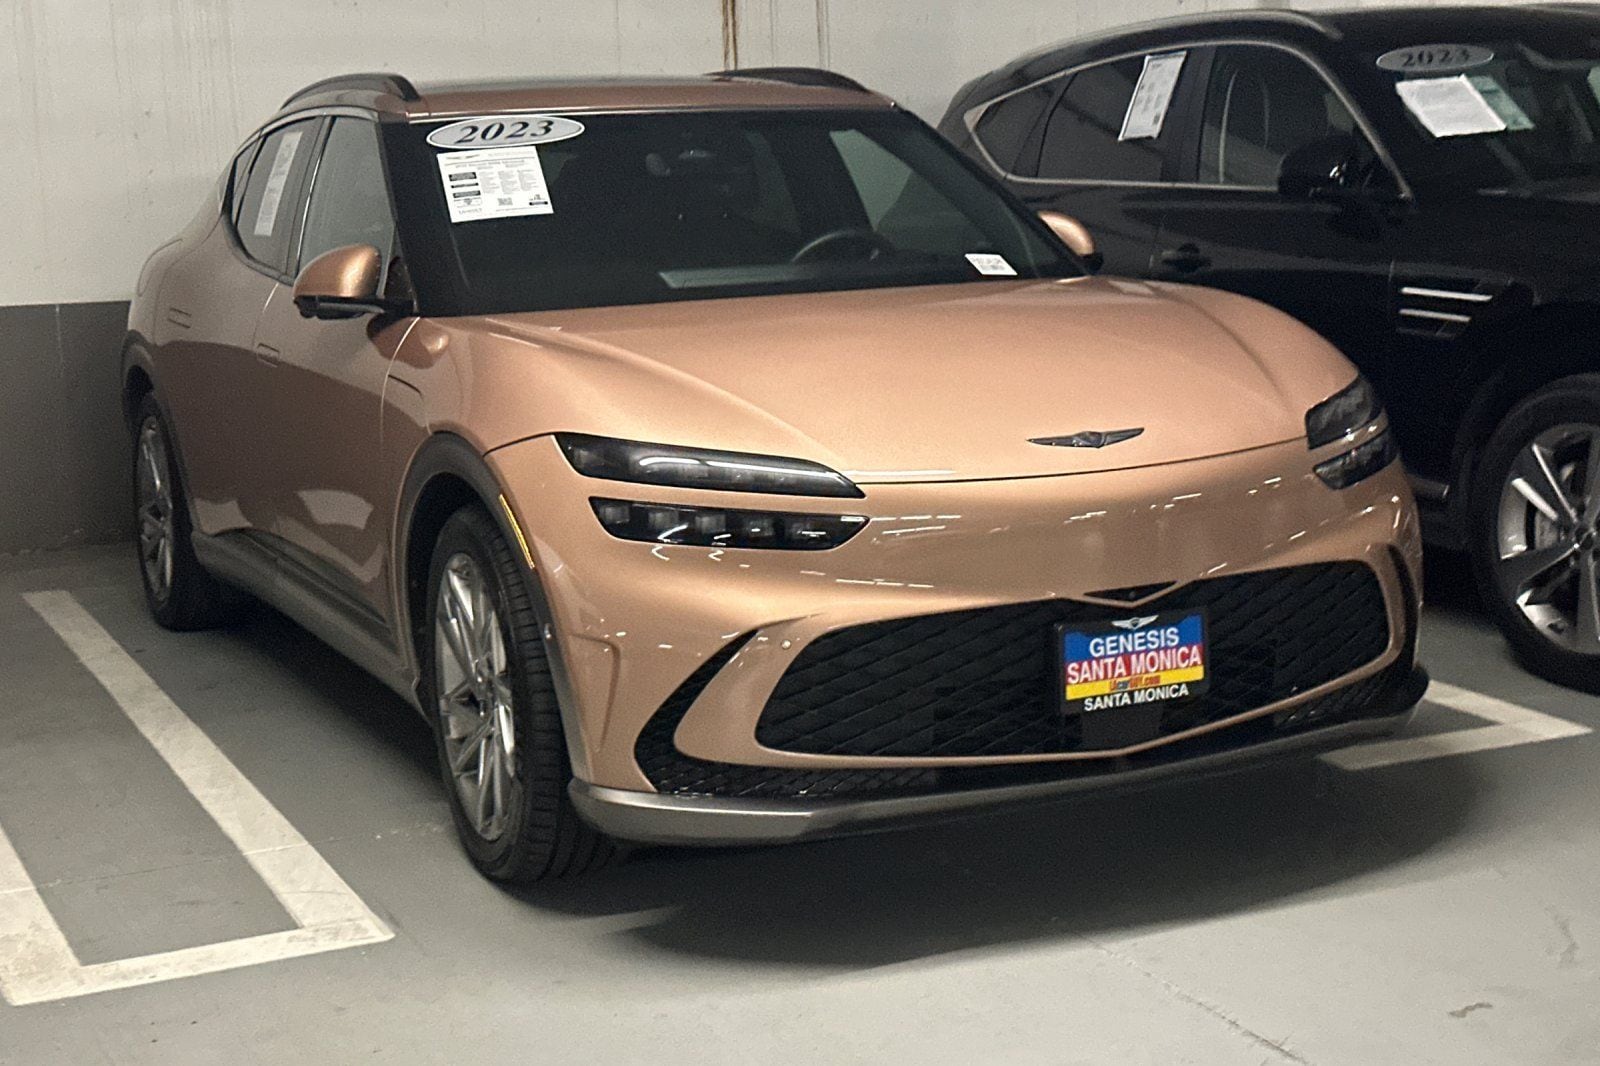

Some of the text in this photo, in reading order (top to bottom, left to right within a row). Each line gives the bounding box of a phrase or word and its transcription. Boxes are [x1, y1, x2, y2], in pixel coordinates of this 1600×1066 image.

[1402, 49, 1470, 67] 2023
[454, 120, 554, 144] 2023
[1089, 627, 1180, 657] GENESIS
[1067, 645, 1202, 684] SANTA MONICA
[1084, 683, 1189, 712] SANTA MONICA
